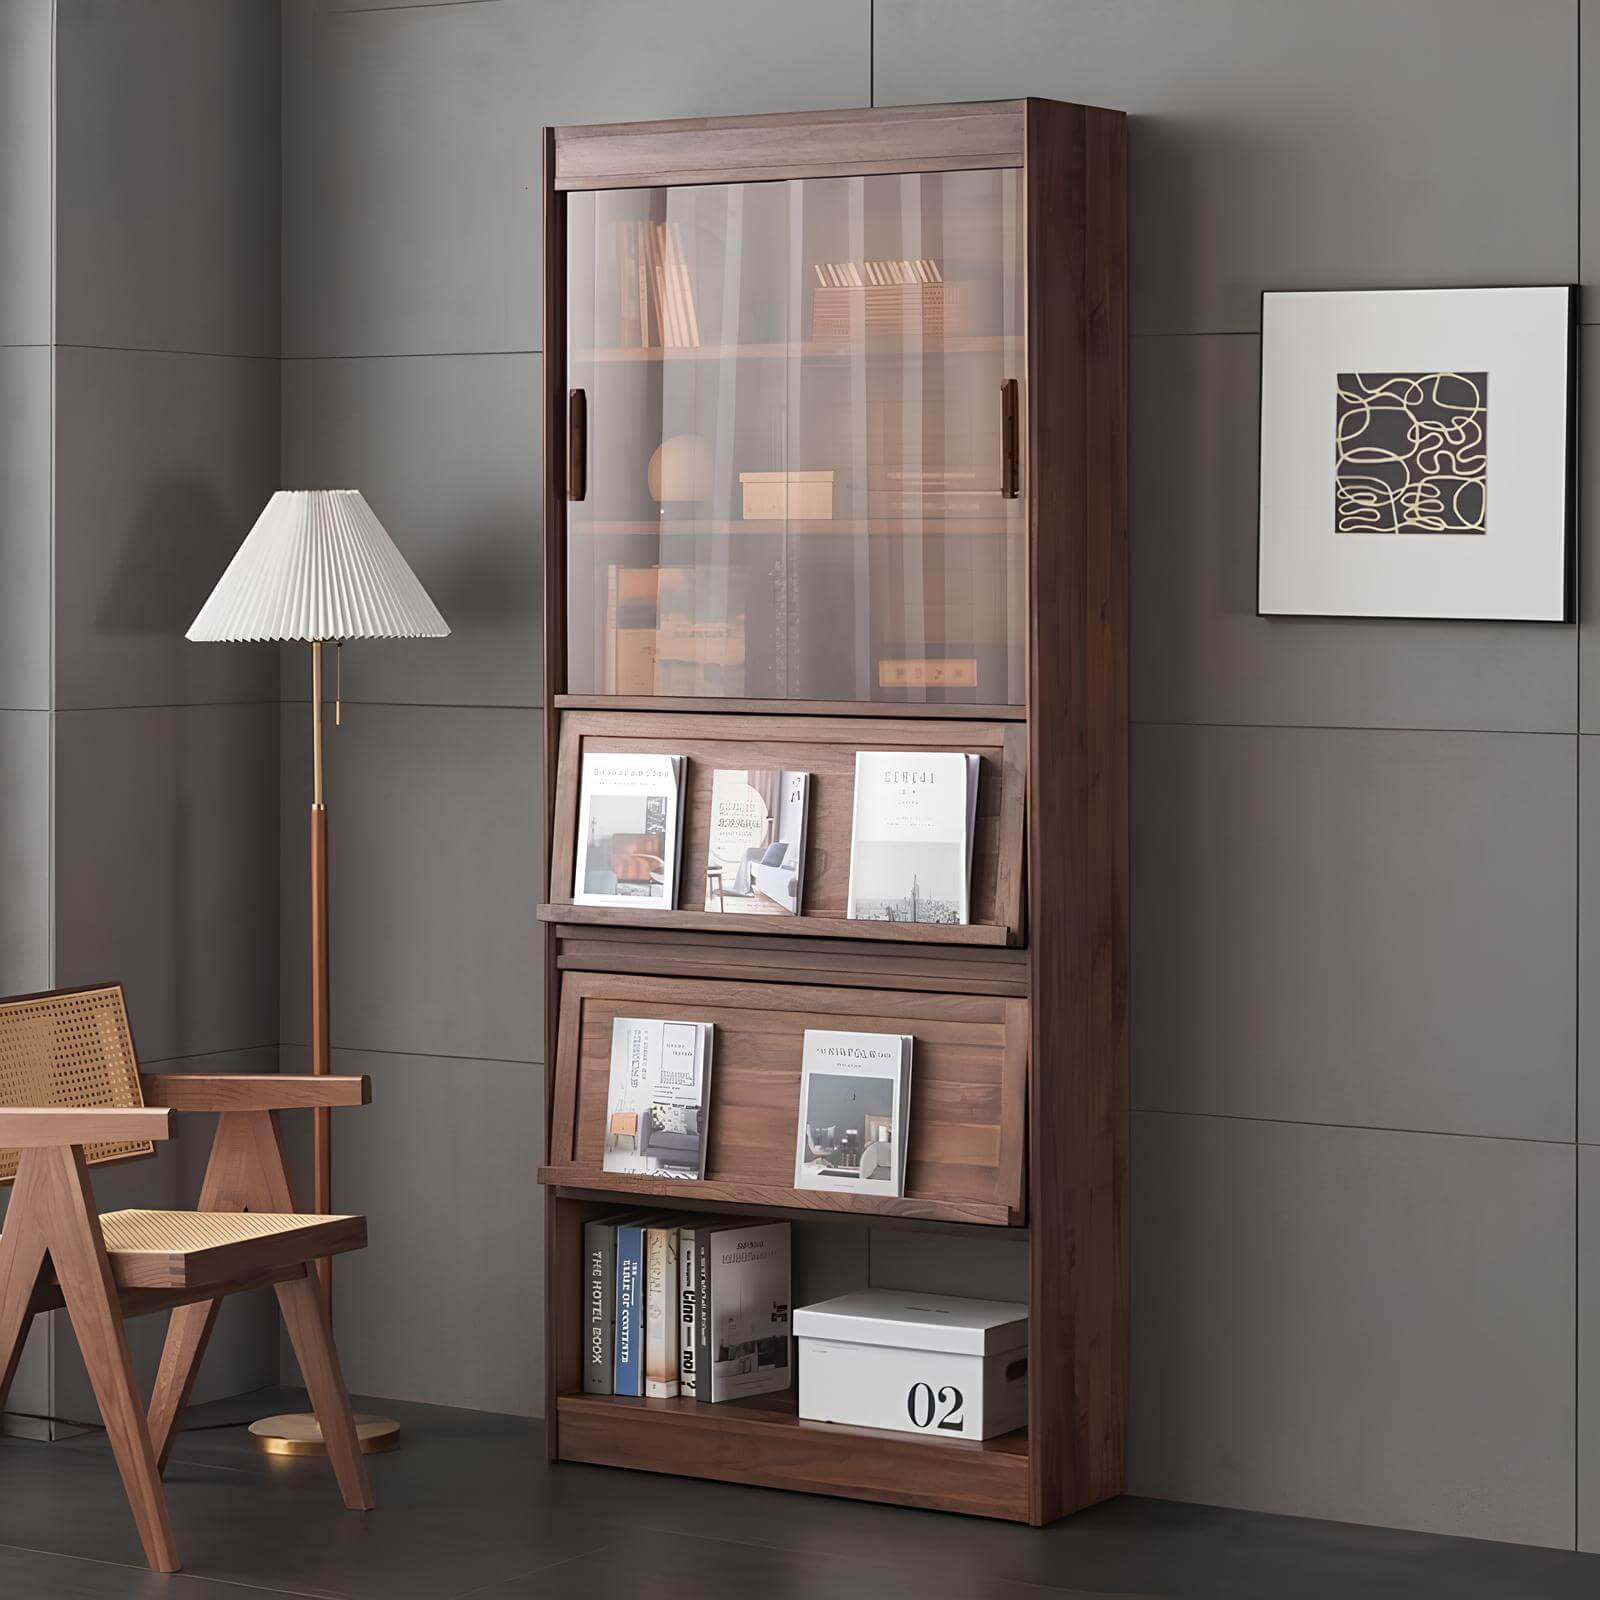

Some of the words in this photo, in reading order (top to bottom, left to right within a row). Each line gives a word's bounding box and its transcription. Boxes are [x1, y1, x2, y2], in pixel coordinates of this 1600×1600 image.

[592, 1250, 602, 1277] THE
[592, 1280, 602, 1323] HOTEL
[907, 1382, 964, 1432] 02
